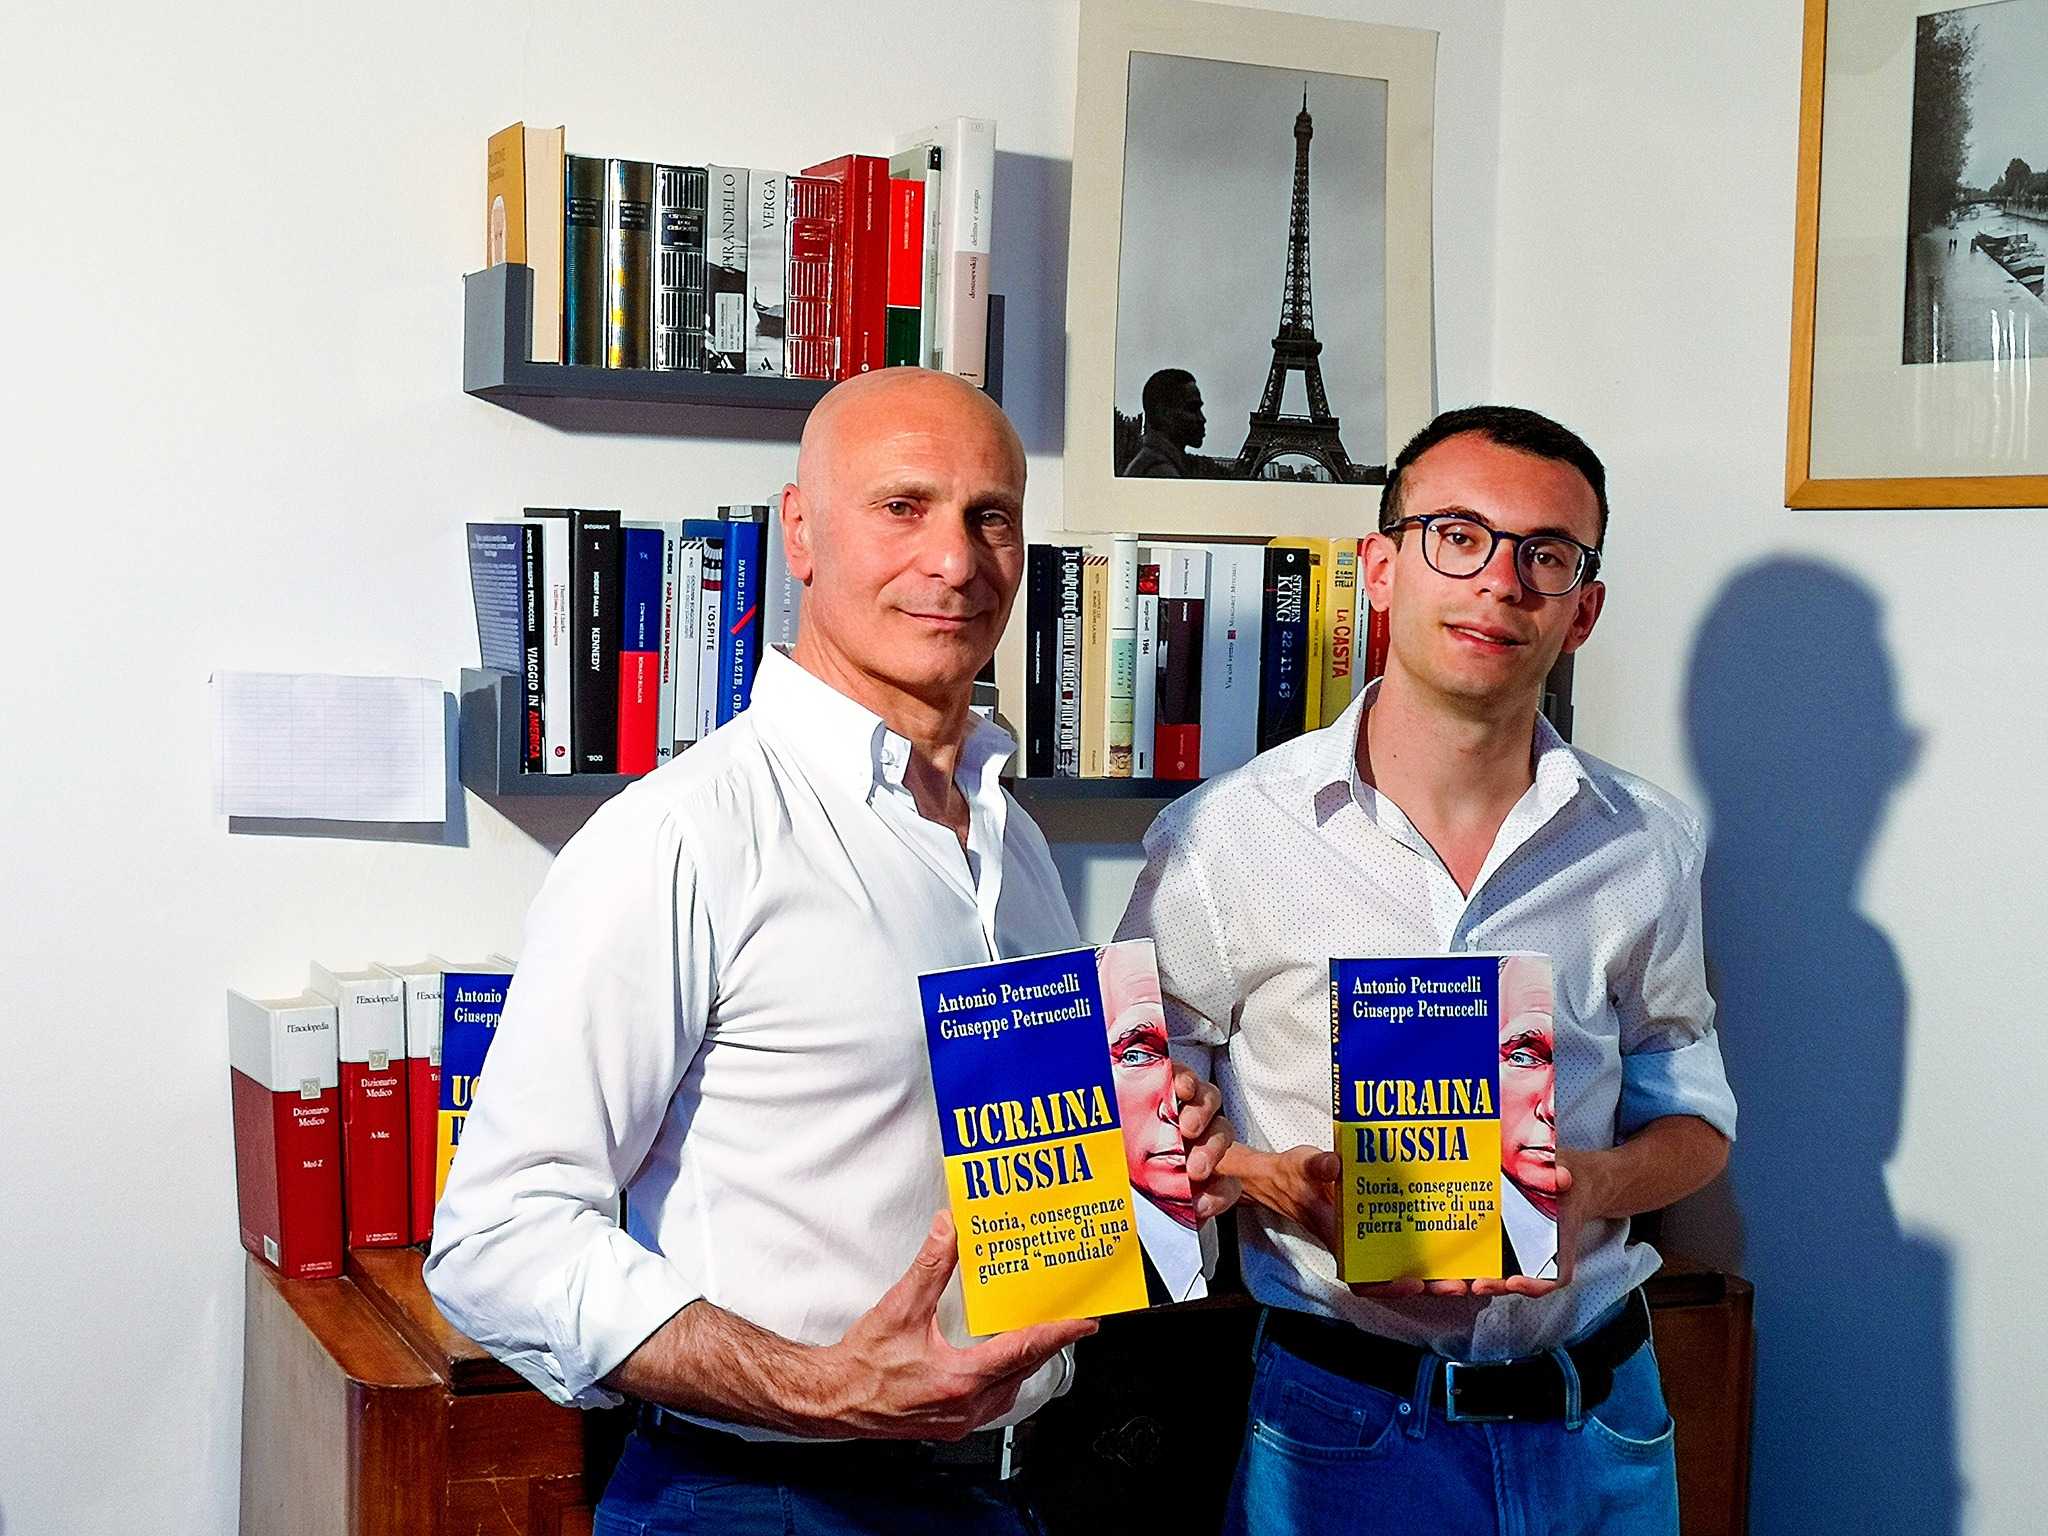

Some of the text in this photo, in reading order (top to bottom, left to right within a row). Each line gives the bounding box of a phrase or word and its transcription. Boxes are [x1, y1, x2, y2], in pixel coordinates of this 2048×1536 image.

[722, 174, 736, 267] PIRANDELLO
[762, 178, 776, 230] VERGA
[1276, 574, 1292, 622] KING
[1292, 574, 1302, 623] STEPHEN
[706, 605, 716, 650] L'OSPITE
[1063, 613, 1076, 646] CONTRO
[1332, 609, 1350, 679] LA CASTA
[592, 627, 600, 672] KENNEDY
[732, 639, 744, 689] GRAZIE,
[1062, 648, 1075, 692] L'AMERICA
[527, 646, 539, 759] VIAGGIO IN AMERICA
[1062, 699, 1073, 726] PHILIP
[1061, 728, 1073, 750] ROTH
[455, 988, 501, 1003] Antonio
[937, 974, 1080, 1014] Antonio Petruccelli
[1352, 976, 1481, 994] Antonio Petruccelli
[454, 1008, 500, 1028] Giusepp
[940, 999, 1092, 1042] Giuseppe Petruccelli
[1352, 1000, 1488, 1023] Giuseppe Petruccelli
[304, 1083, 318, 1095] 28
[366, 1088, 393, 1097] Medico
[1354, 1078, 1494, 1117] UCRAINA
[298, 1117, 325, 1126] Medico
[953, 1085, 1113, 1148] UCRAINA
[1355, 1126, 1469, 1162] RUSSIA
[962, 1143, 1094, 1200] RUSSIA
[1356, 1177, 1493, 1197] Storia, conseguenze
[971, 1198, 1125, 1236] Storia, conseguenze
[1357, 1197, 1495, 1217] e prospettive di una
[1357, 1213, 1485, 1239] guerra “mondiale”
[975, 1219, 1129, 1260] e prospettive di una
[978, 1237, 1122, 1284] guerra “mondiale”
